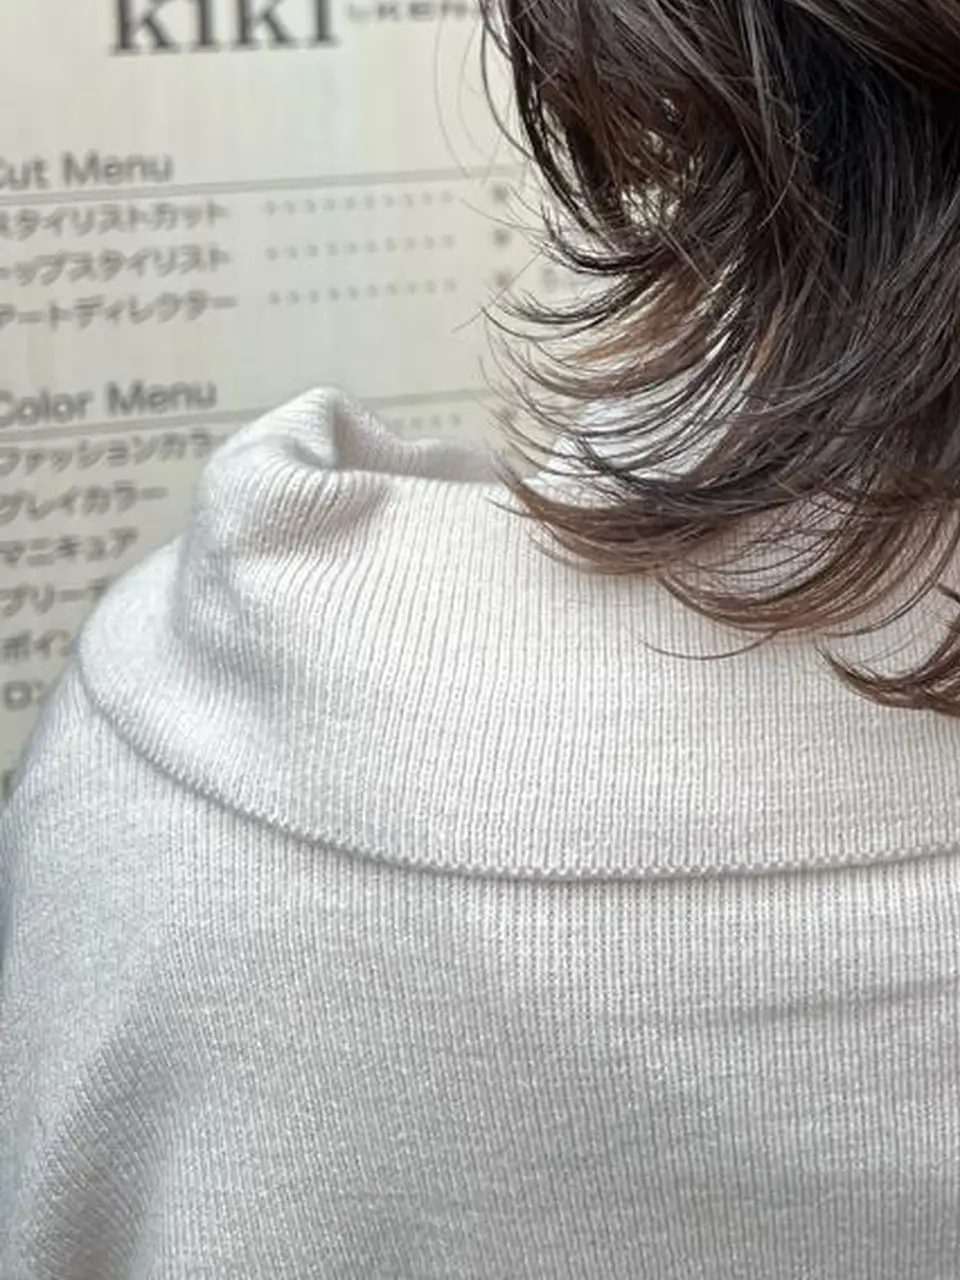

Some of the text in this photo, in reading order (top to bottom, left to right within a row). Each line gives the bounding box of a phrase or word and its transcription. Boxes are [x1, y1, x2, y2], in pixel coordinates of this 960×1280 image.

[0, 150, 174, 191] ut Menu
[106, 380, 217, 415] Menu
